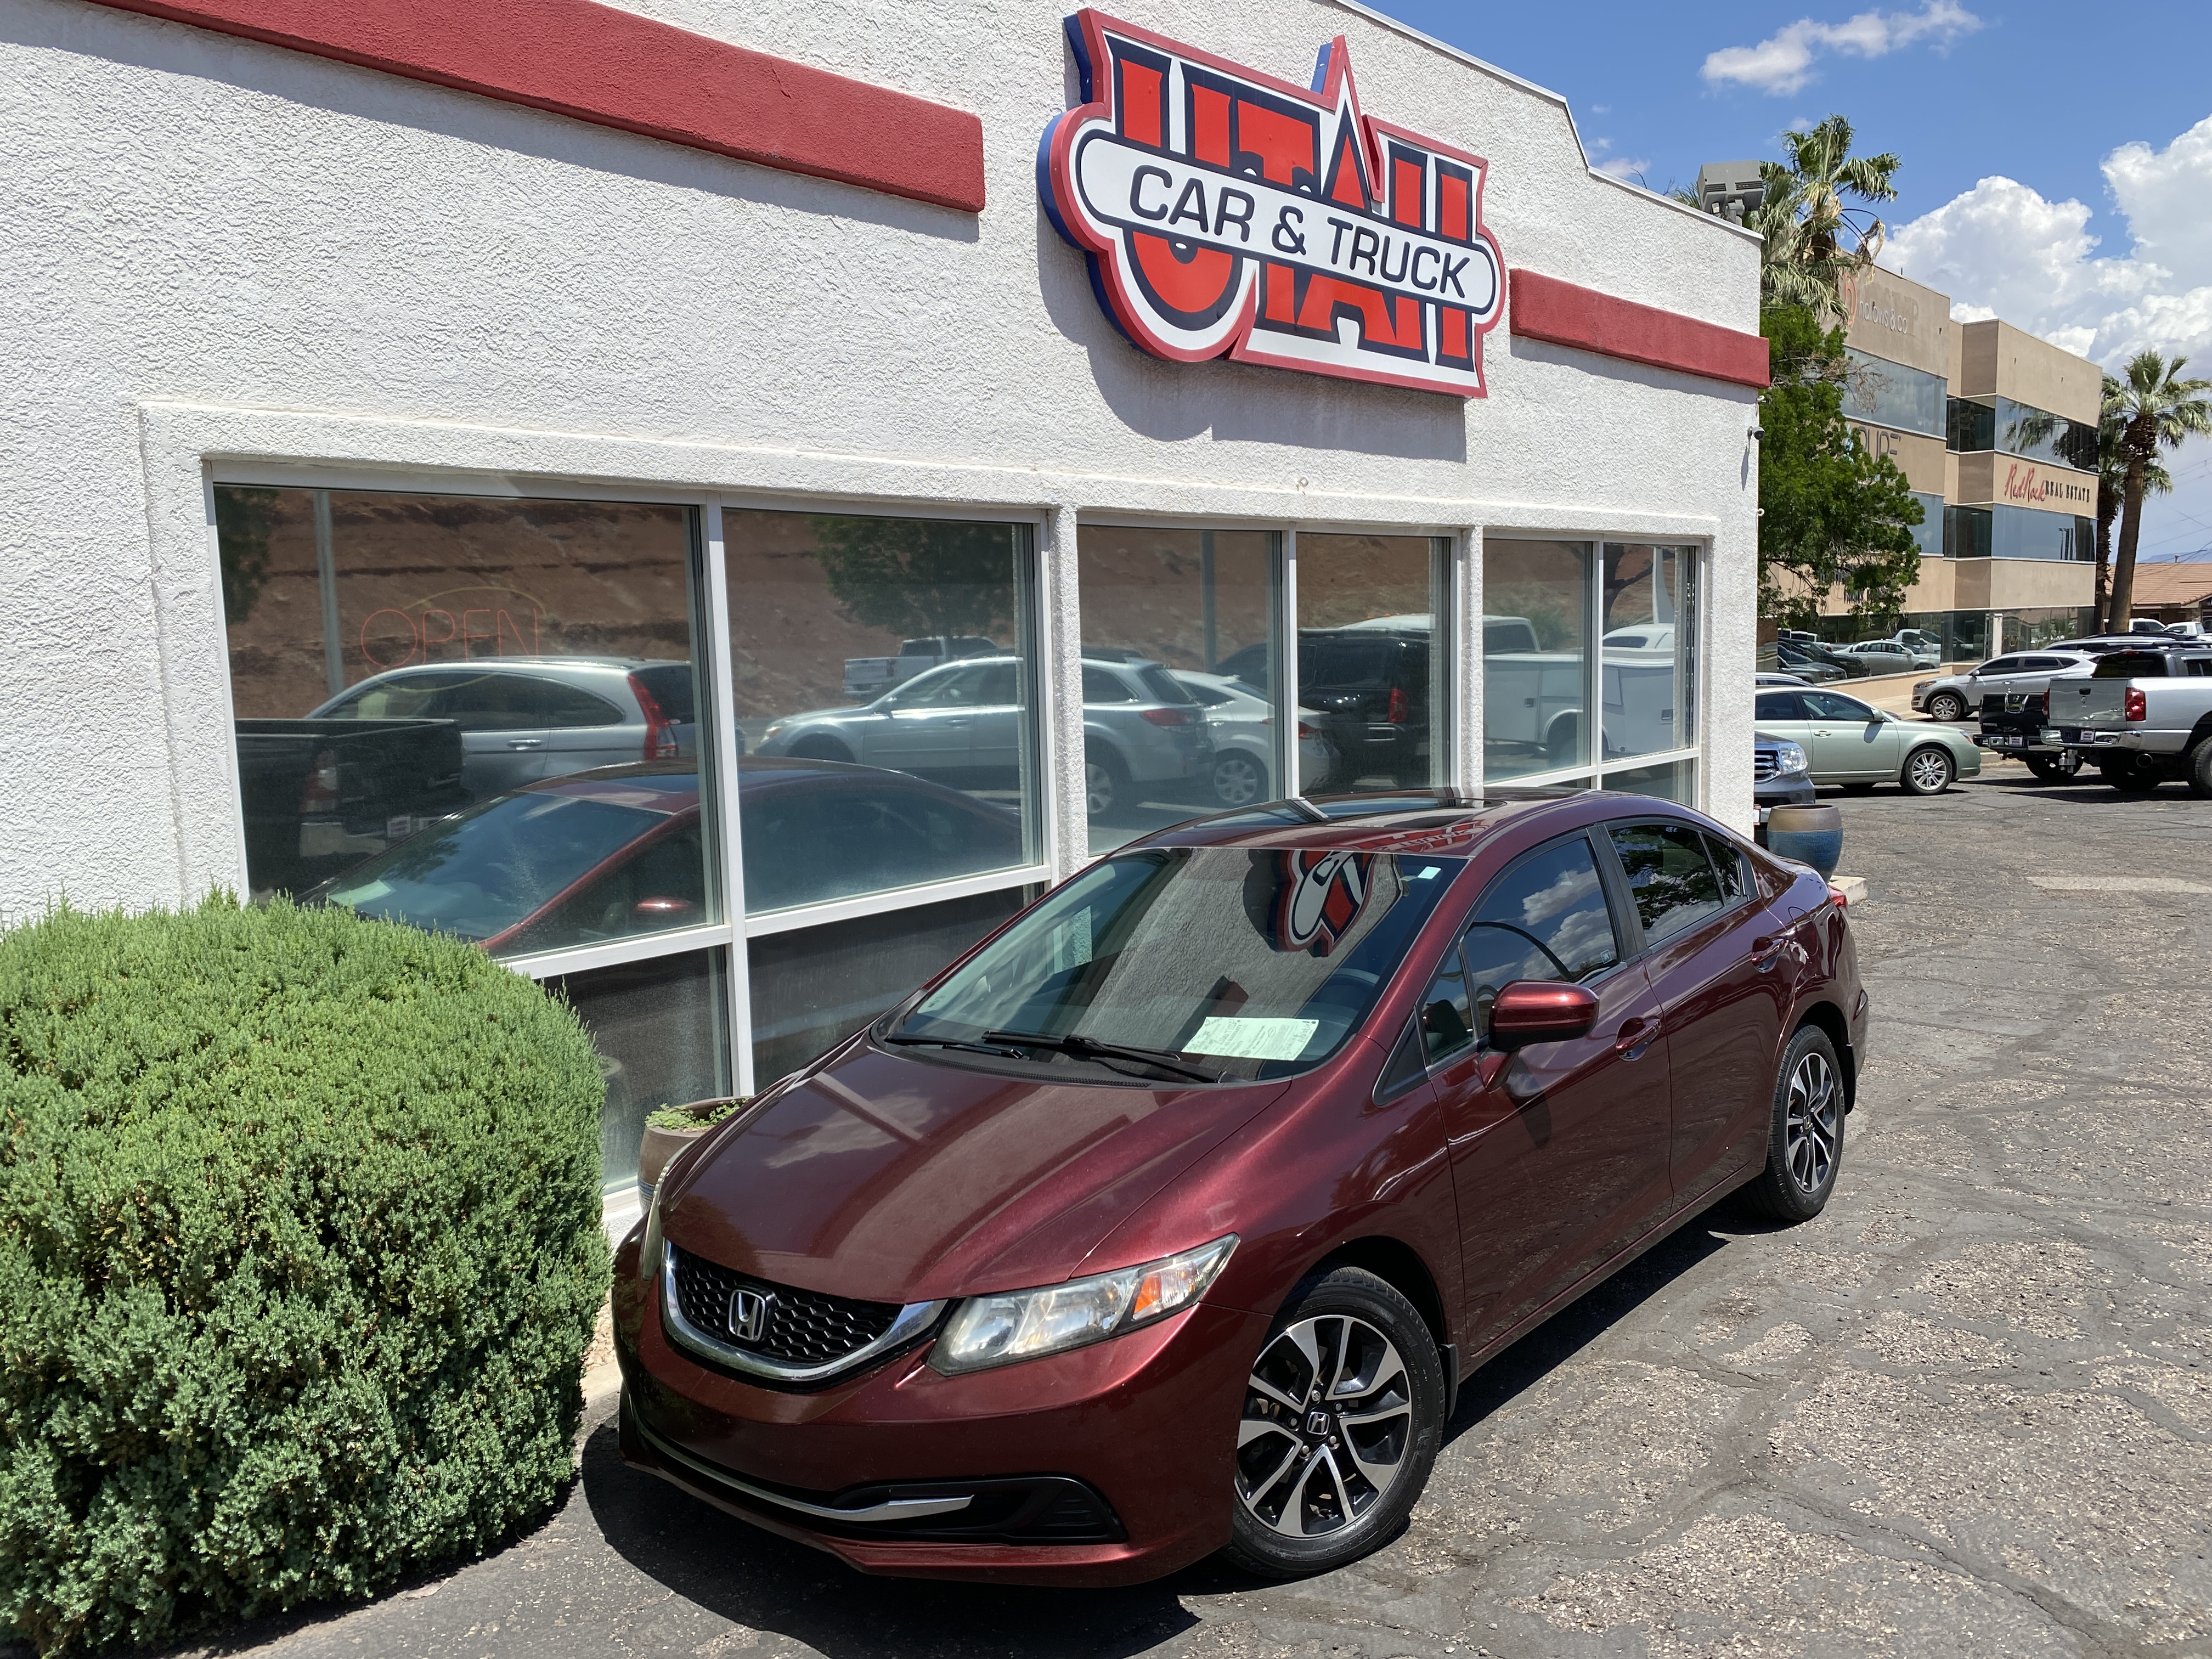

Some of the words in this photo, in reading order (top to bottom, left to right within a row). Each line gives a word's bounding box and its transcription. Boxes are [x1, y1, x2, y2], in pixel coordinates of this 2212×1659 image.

[1104, 33, 1476, 372] UTAH
[1130, 165, 1255, 243] CAR
[1271, 205, 1307, 256] &
[1327, 216, 1471, 299] TRUCK
[1889, 308, 1897, 332] &
[2045, 480, 2063, 499] REAL
[2066, 484, 2090, 503] ESTATE
[360, 608, 539, 668] OPEN
